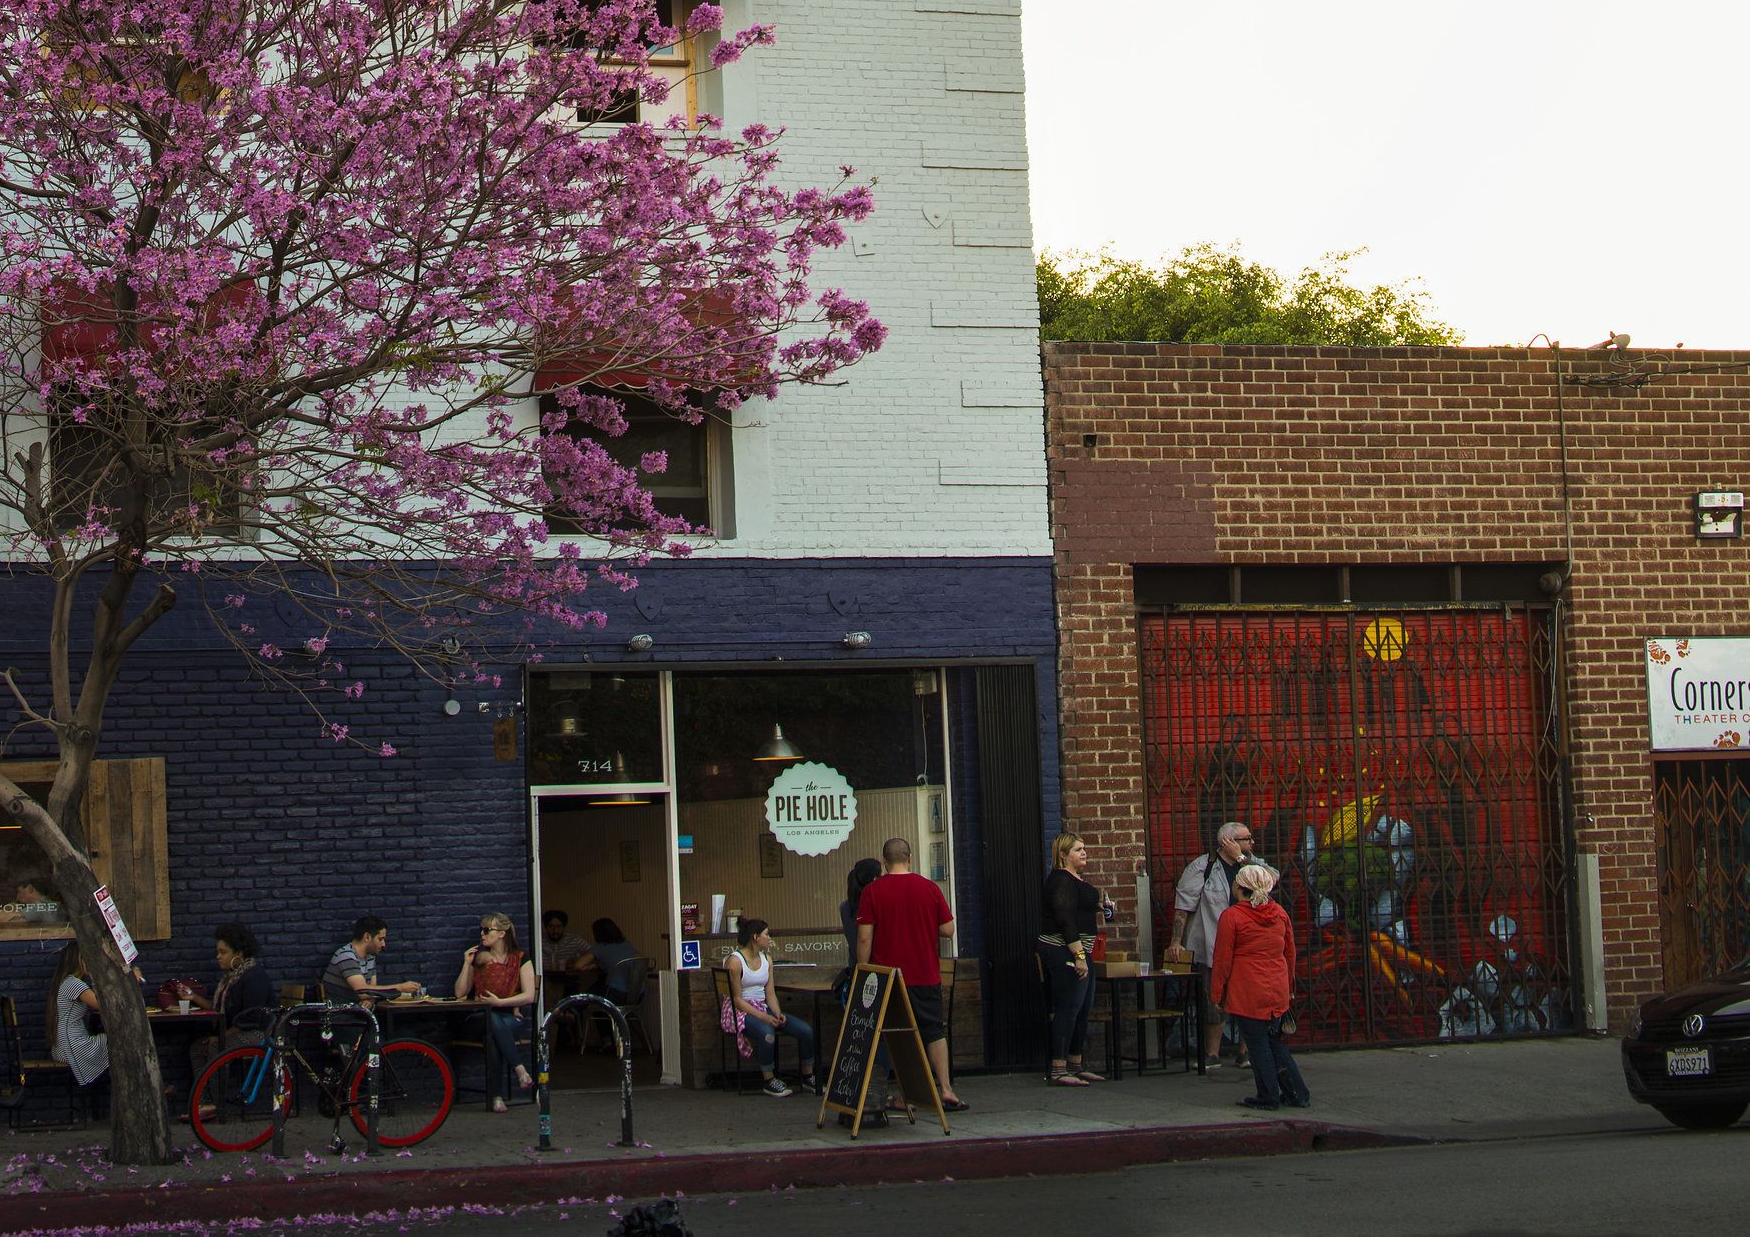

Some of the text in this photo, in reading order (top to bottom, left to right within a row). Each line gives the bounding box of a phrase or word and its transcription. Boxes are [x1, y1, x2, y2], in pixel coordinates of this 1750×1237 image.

[1670, 667, 1750, 711] Corner
[1674, 714, 1738, 724] THEATER
[578, 760, 613, 772] 714
[805, 781, 818, 792] the
[775, 794, 849, 822] PIE HOLE
[784, 941, 842, 953] SAVORY
[1670, 1057, 1707, 1072] 6XDS971
